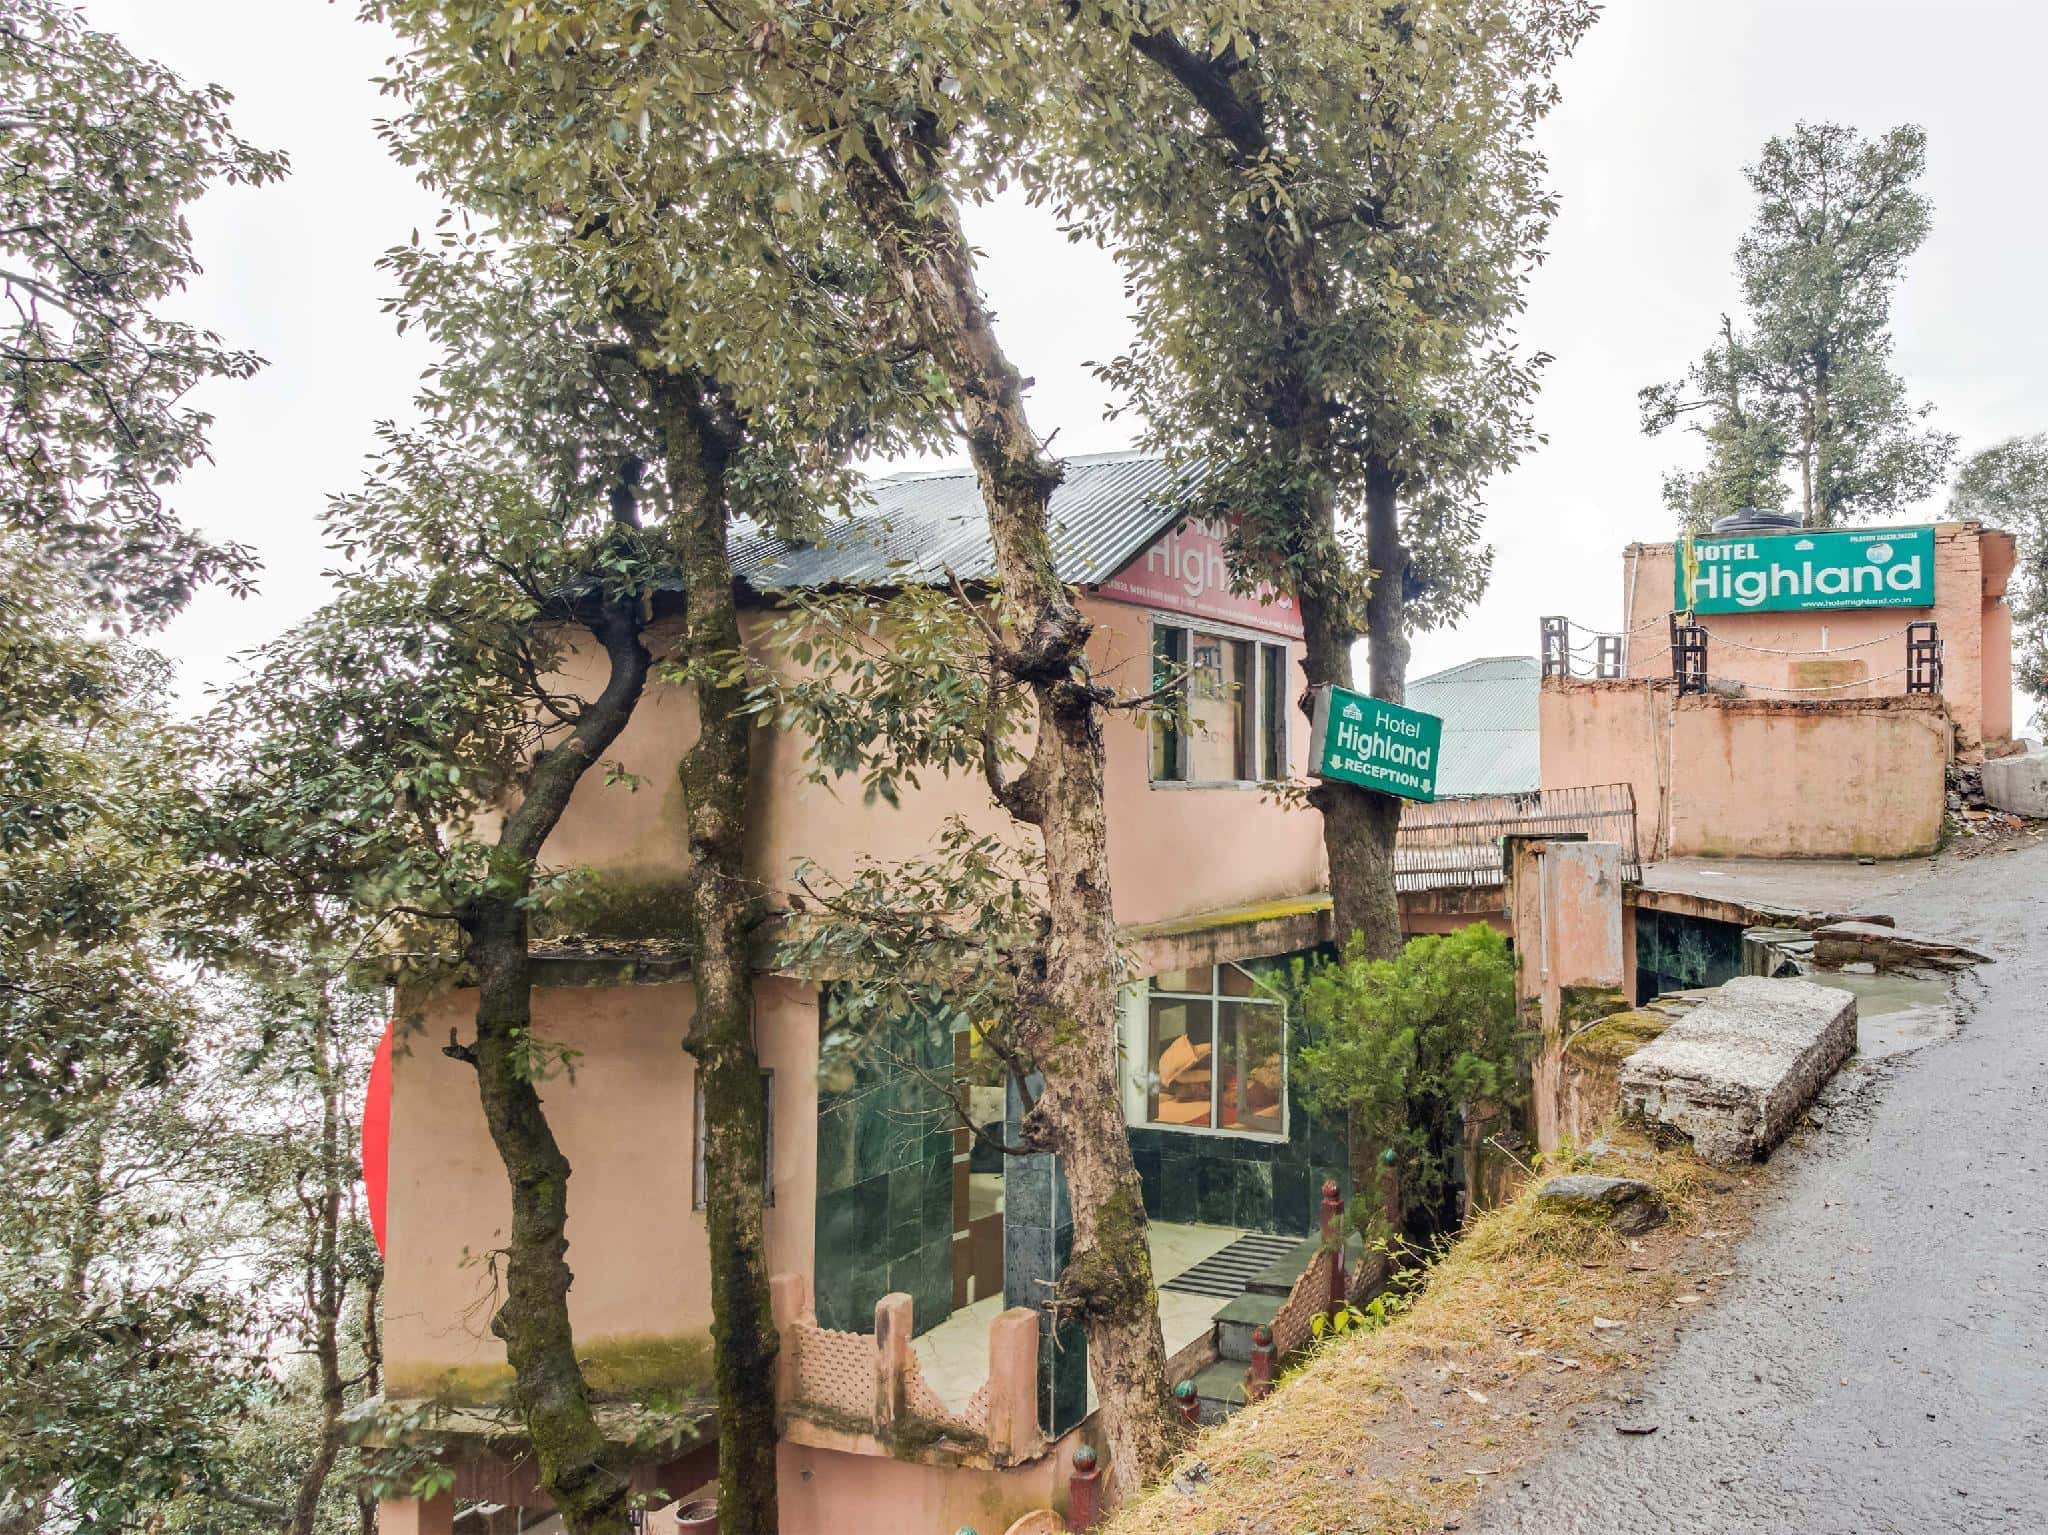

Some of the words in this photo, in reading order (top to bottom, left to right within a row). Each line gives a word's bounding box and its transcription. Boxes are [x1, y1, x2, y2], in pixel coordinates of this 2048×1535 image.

[1694, 543, 1760, 561] HOTEL
[1692, 555, 1921, 607] Highland
[1375, 710, 1420, 739] Hotel
[1337, 721, 1431, 771] Highland
[1344, 757, 1419, 788] RECEPTION
